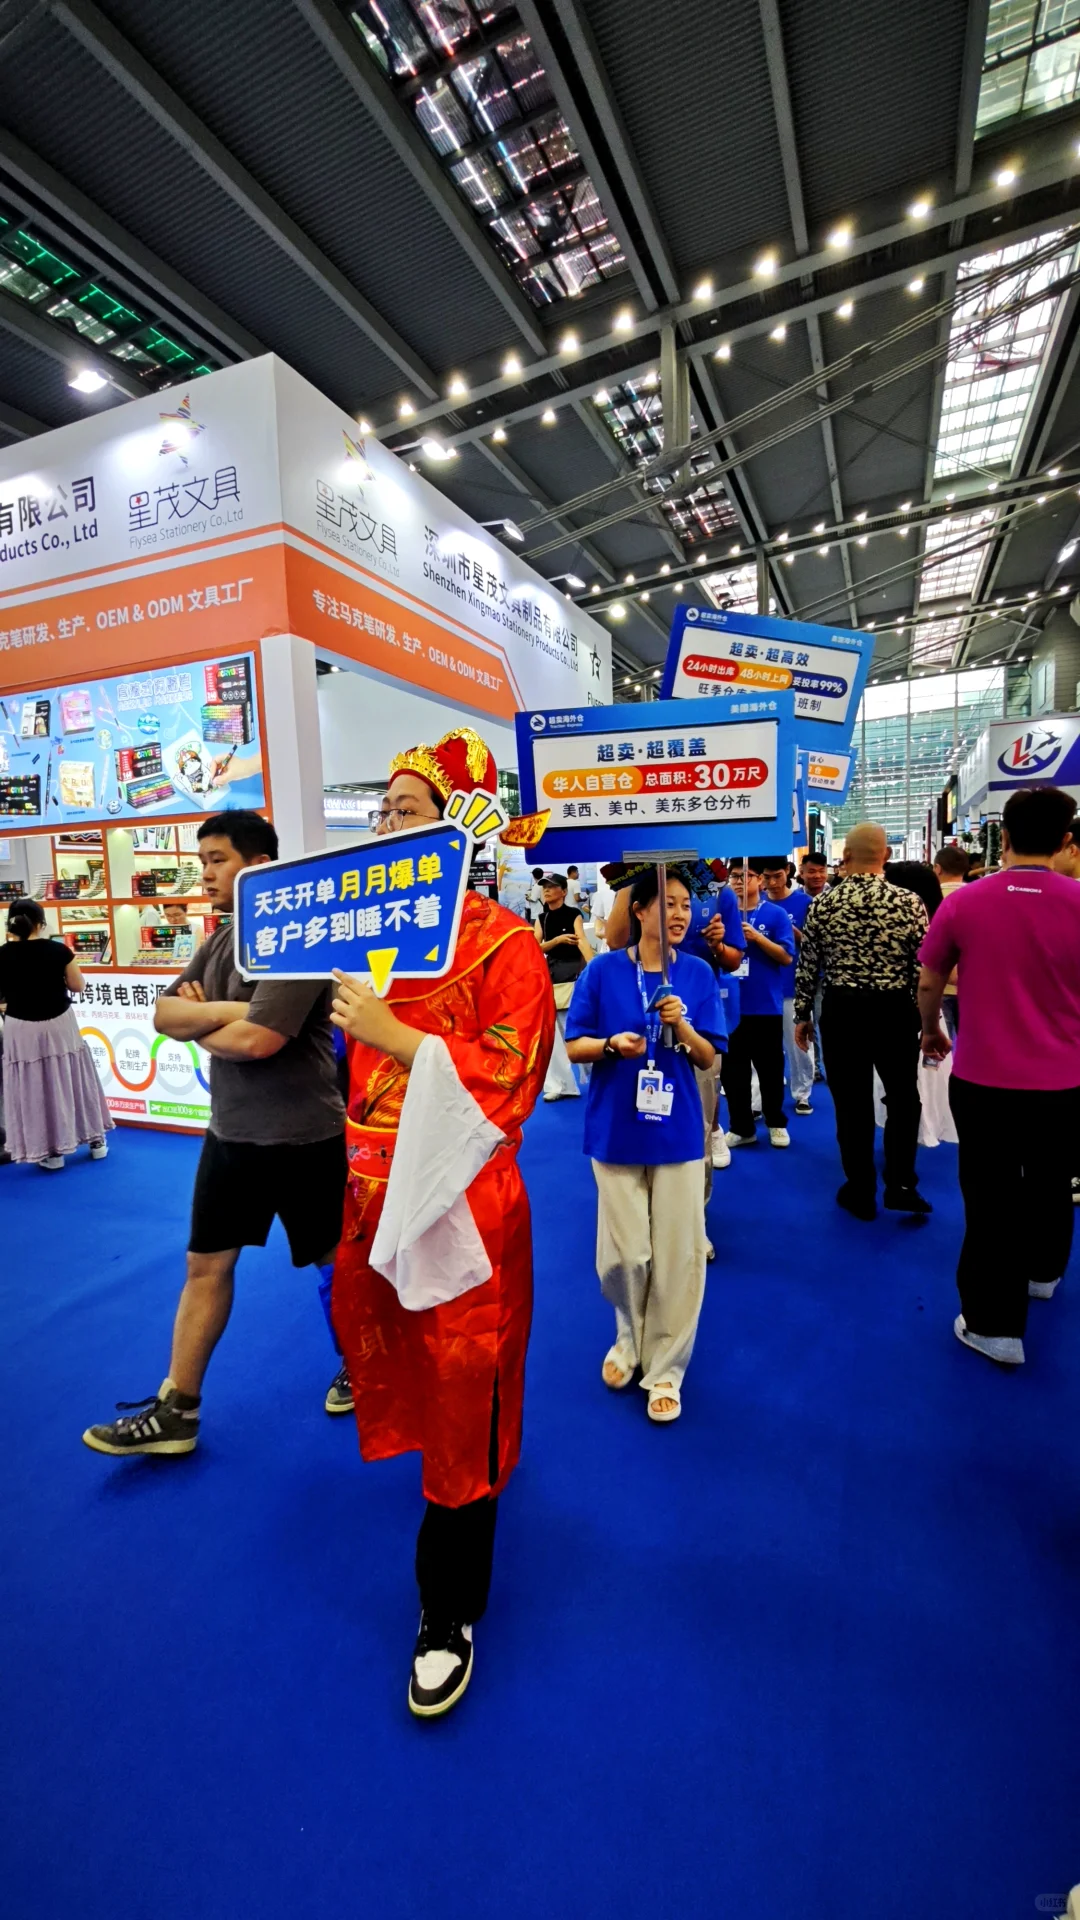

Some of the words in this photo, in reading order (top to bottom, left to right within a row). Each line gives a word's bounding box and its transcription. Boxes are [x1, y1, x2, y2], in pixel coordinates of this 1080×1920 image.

[0, 476, 97, 538] 有限公司
[128, 466, 241, 532] 星茂文具
[41, 532, 71, 551] Co.,
[73, 518, 99, 543] Ltd
[129, 533, 158, 549] Flysea
[159, 519, 208, 541] Stationery
[316, 479, 399, 562] 星茂文具
[316, 519, 341, 544] Flysea
[342, 534, 378, 567] Stationery
[96, 605, 130, 630] OEM
[132, 603, 145, 623] &
[147, 594, 184, 619] ODM
[187, 577, 254, 613] 文具工厂
[423, 561, 467, 599] Shenzhen
[468, 589, 501, 623] Xingmao
[502, 614, 535, 648] Stationery
[535, 634, 560, 661] Products
[570, 656, 579, 672] Ltd
[428, 646, 449, 669] OEM
[449, 656, 457, 672] &
[457, 659, 476, 681] ODM
[476, 668, 504, 692] 文具工厂
[729, 641, 810, 667] 超卖·超高效
[686, 659, 736, 677] 24小时出库
[739, 666, 790, 685] 48小时上网
[793, 675, 843, 694] 妥投率99%
[730, 701, 777, 715] 美国海外仓
[793, 697, 822, 712] 班制
[597, 737, 707, 762] 超卖·超覆盖
[553, 772, 634, 793] 华人自营仓
[562, 794, 752, 819] 美西、美中、美东多仓分布
[254, 852, 444, 918] 天天开单月月爆单
[255, 894, 442, 957] 客户多到睡不着
[119, 1060, 149, 1072] 定制生产
[125, 1048, 140, 1059] 贴牌
[159, 1063, 193, 1074] 国内外定制
